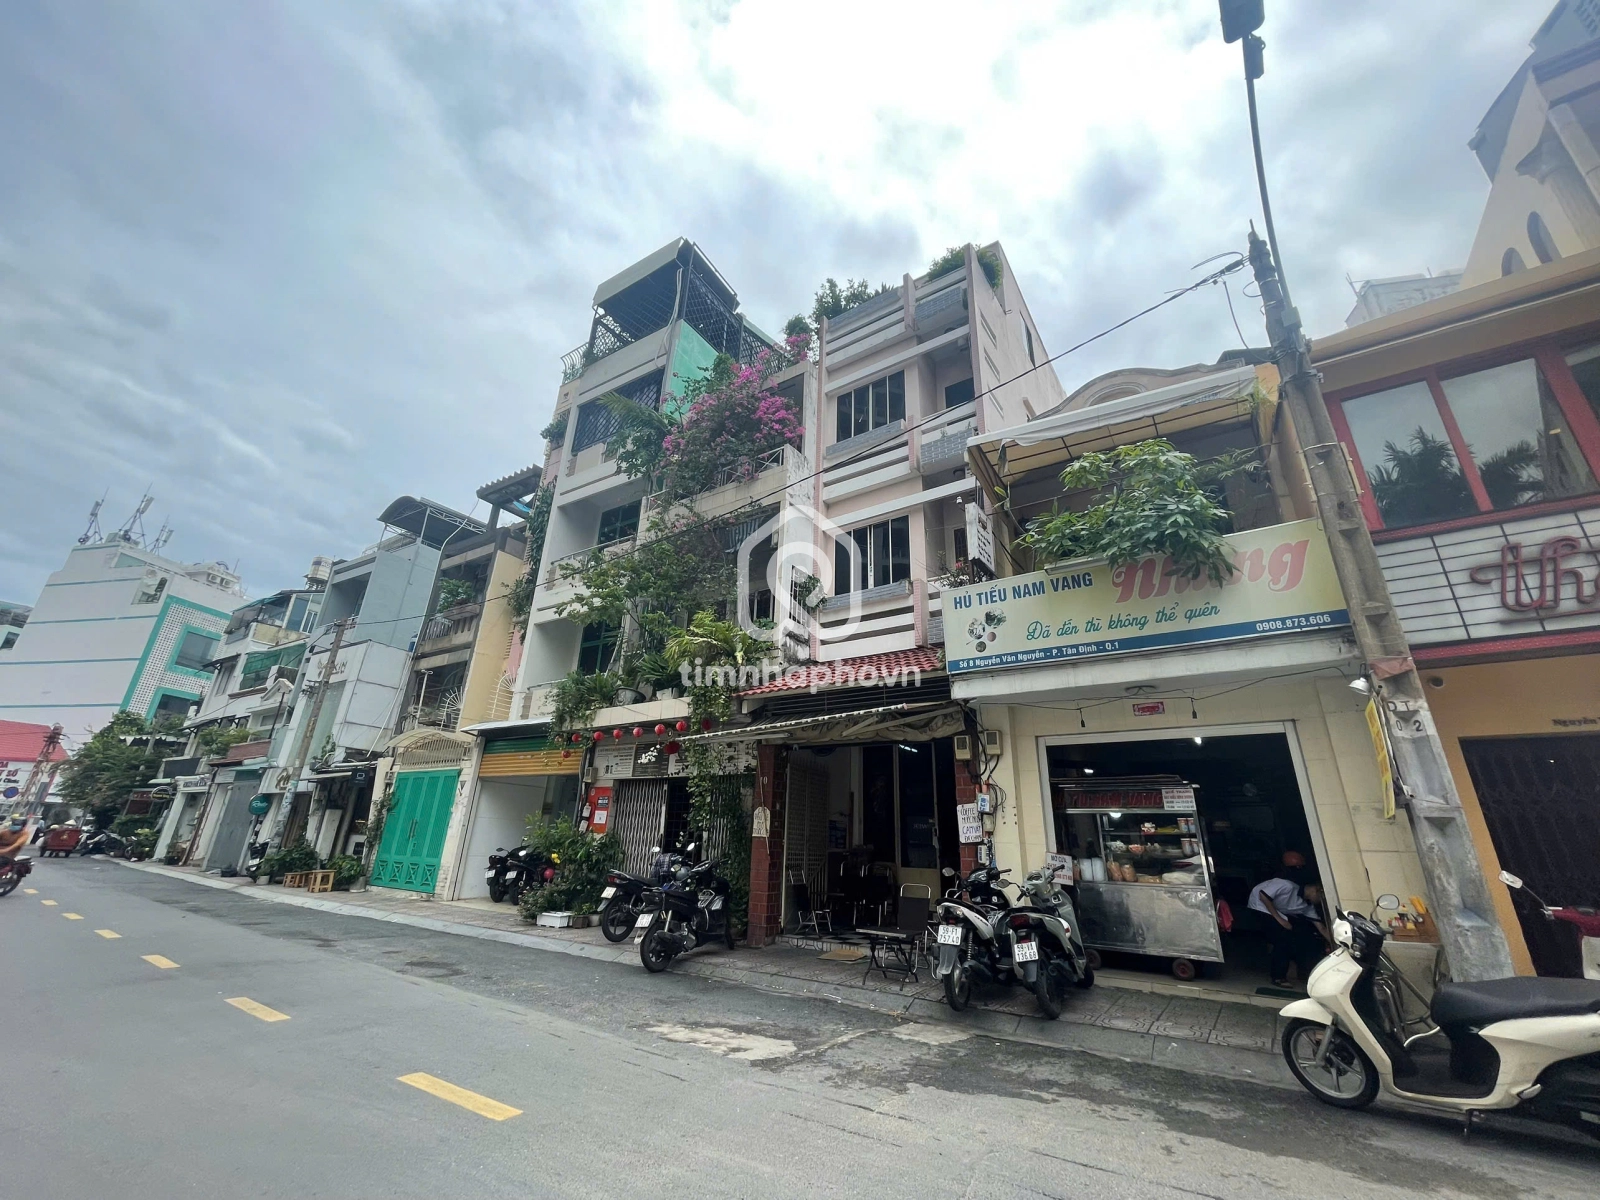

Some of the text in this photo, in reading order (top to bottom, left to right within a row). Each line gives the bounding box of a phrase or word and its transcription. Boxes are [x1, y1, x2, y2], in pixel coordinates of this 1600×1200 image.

[953, 572, 1094, 610] HỦ TIẾU NAM VANG
[1026, 602, 1221, 641] Đã đến thì không thể quên
[1256, 614, 1331, 631] 0908.873.606
[975, 656, 1001, 667] Nguyễn
[1002, 655, 1016, 663] Văn
[1018, 650, 1045, 661] Nguyễn
[1052, 649, 1061, 657] P.
[1062, 646, 1077, 655] Tân
[1078, 645, 1097, 654] Định
[1105, 642, 1119, 650] Q.1
